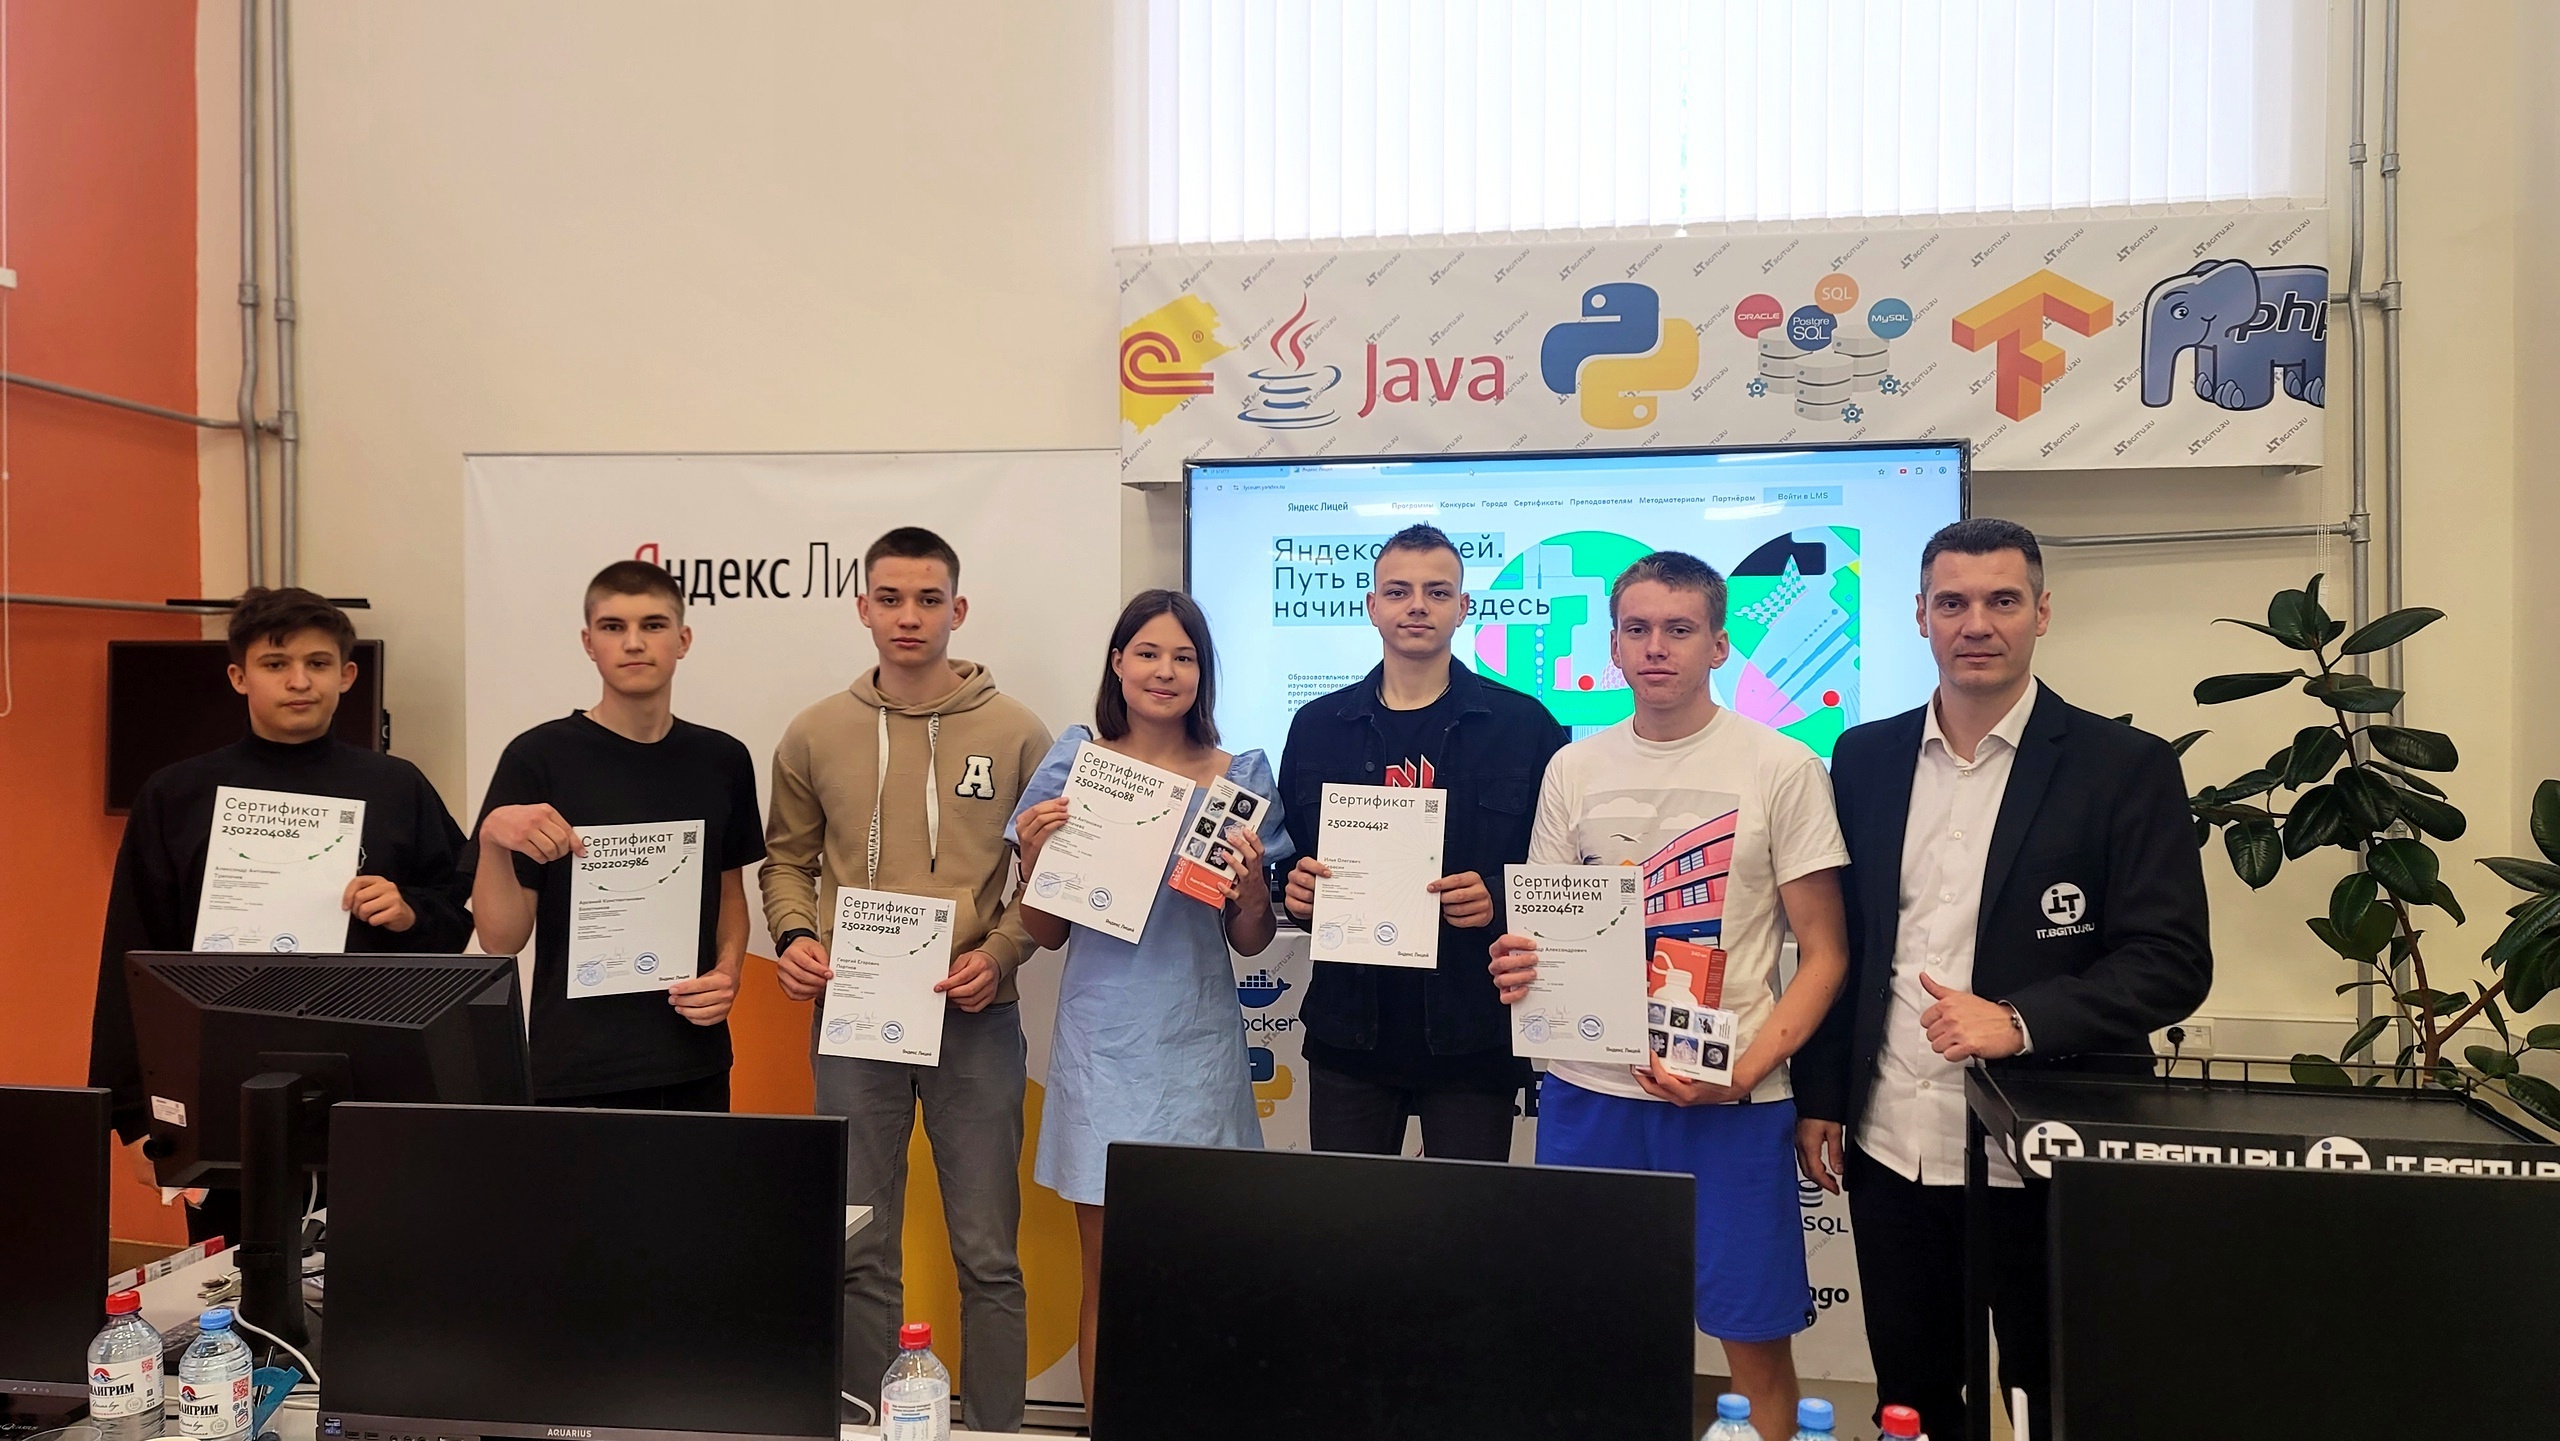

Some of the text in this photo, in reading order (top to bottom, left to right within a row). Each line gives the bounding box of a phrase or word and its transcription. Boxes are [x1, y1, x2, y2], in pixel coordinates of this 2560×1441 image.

[1822, 287, 1852, 301] SQL
[1738, 312, 1780, 320] ORACLE
[1793, 317, 1830, 328] Postgre
[1871, 313, 1909, 323] MySQL
[1793, 327, 1830, 341] SQL
[1357, 344, 1505, 418] Java
[1287, 501, 1349, 513] Яндекс Лицей
[1440, 501, 1476, 509] Конкурсы
[1514, 499, 1564, 508] Сертификаты
[1570, 498, 1633, 506] Преподавателям
[1639, 496, 1706, 505] Методматериалы
[1712, 494, 1756, 503] Партнёрам
[1778, 492, 1801, 501] Войти
[1810, 492, 1829, 500] LMS
[1275, 566, 1370, 596] Путь в
[1275, 600, 1363, 617] начин
[1288, 674, 1349, 682] Образовательное
[955, 755, 995, 800] A
[1083, 751, 1165, 789] Сертификат
[1075, 776, 1135, 802] 2502204088
[1079, 765, 1155, 798] с отличием
[225, 797, 329, 818] Сертификат
[1329, 792, 1416, 810] Сертификат
[223, 812, 320, 828] с отличием
[222, 825, 300, 838] 2502204086
[582, 833, 674, 848] Сертификат
[594, 844, 667, 858] отличием
[581, 857, 649, 871] 2502202986
[1513, 874, 1609, 890] Сертификат
[1514, 890, 1602, 901] с отличием
[843, 896, 926, 916] Сертификат
[842, 910, 919, 926] с отличием
[841, 921, 900, 935] 2502209218
[1803, 1216, 1849, 1235] SQL
[547, 1428, 592, 1438] AQUARIUS
